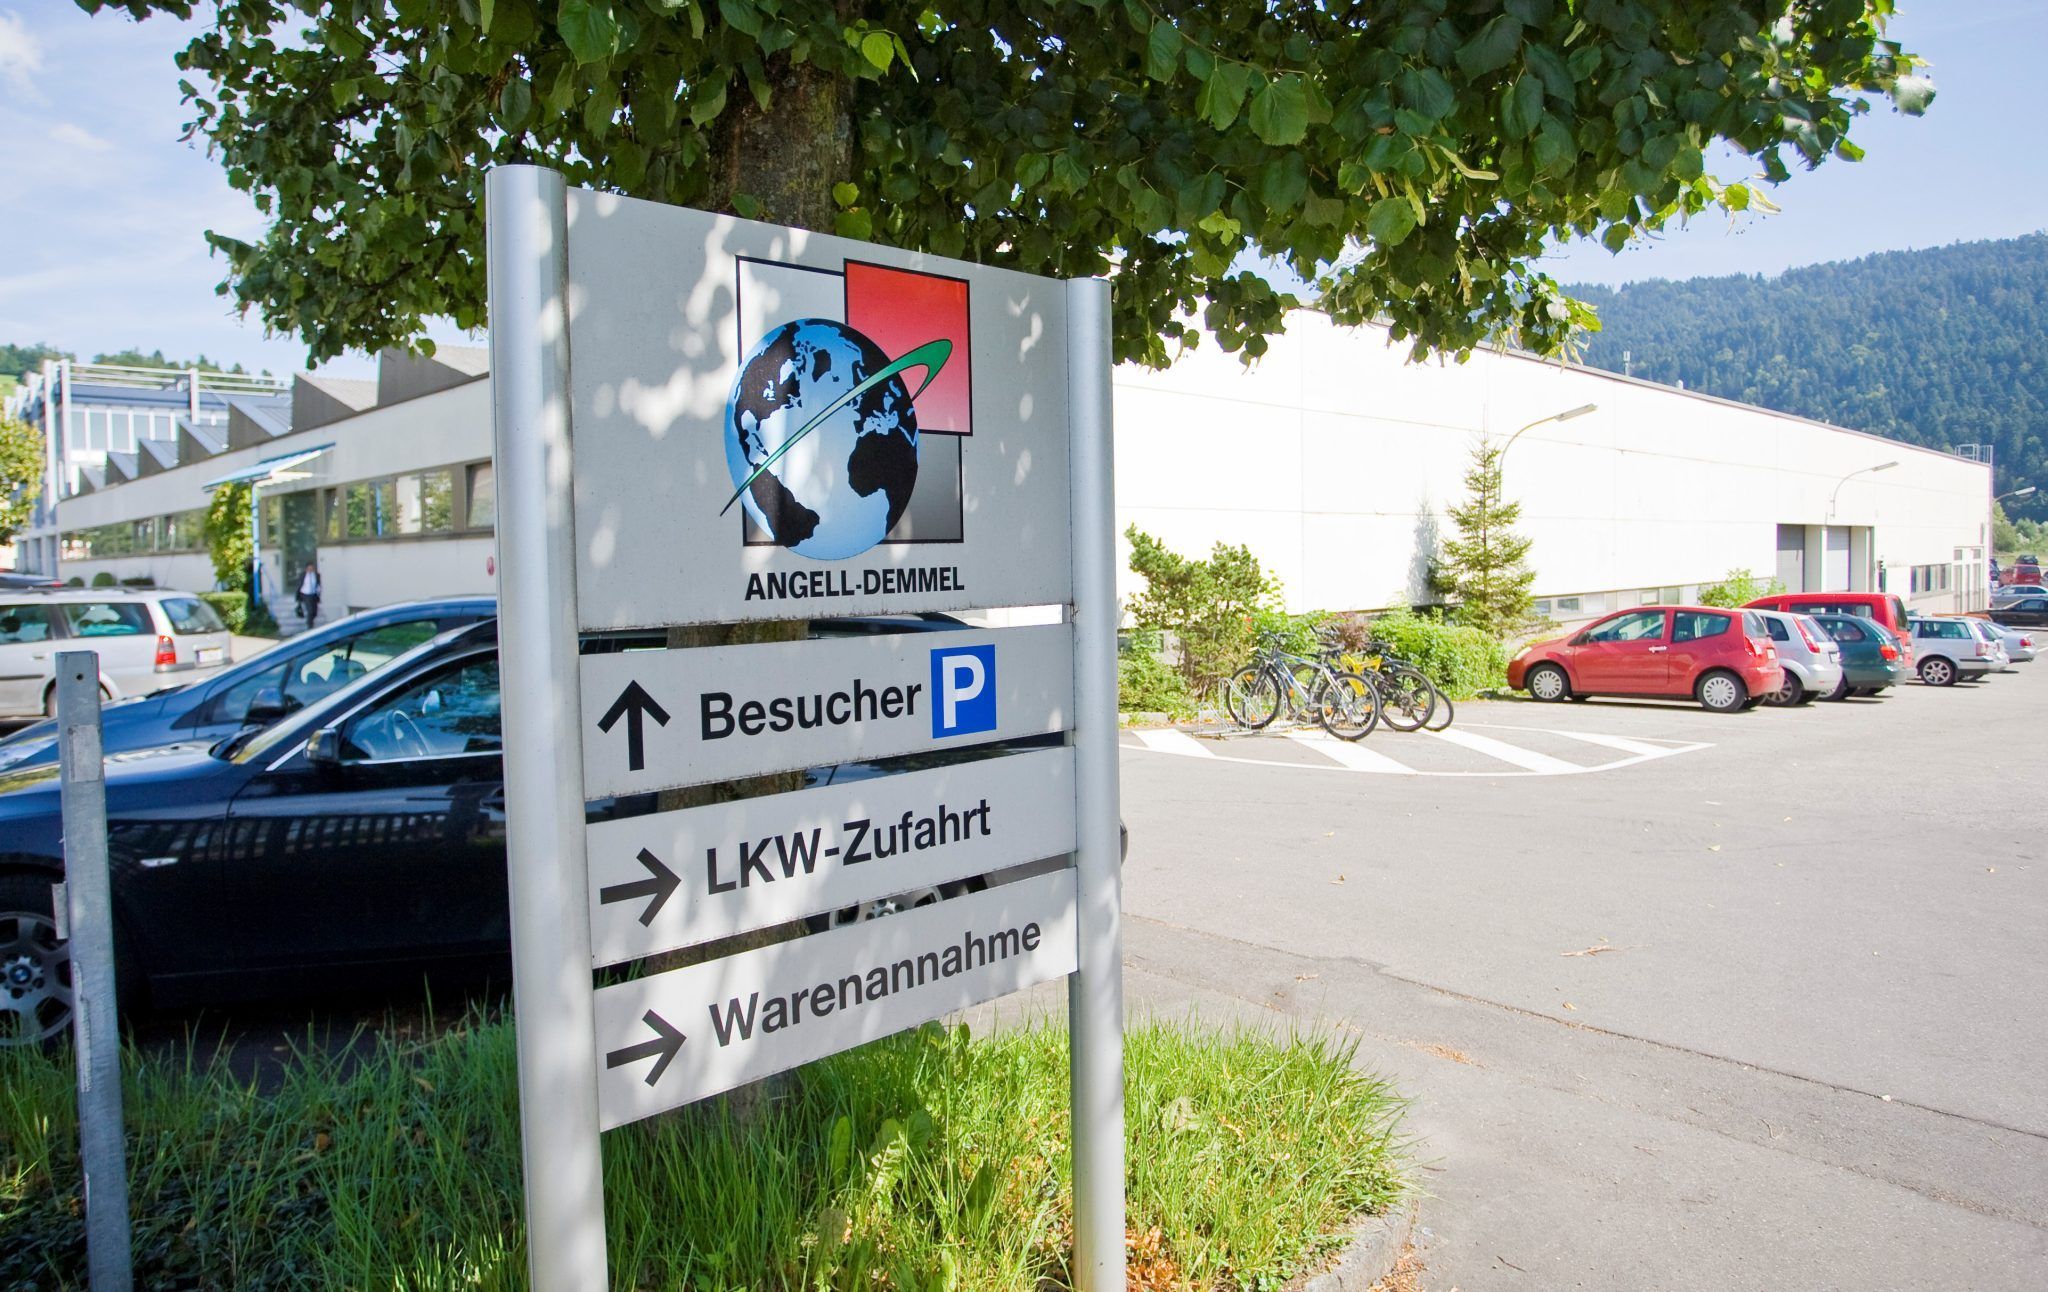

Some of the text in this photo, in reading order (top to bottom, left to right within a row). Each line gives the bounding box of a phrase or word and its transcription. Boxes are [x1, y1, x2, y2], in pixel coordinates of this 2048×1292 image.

[744, 566, 965, 601] ANGELL-DEMMEL
[700, 654, 986, 741] Besucher P
[706, 798, 991, 896] LKW-Zufahrt
[708, 921, 1042, 1048] Warenannahme
